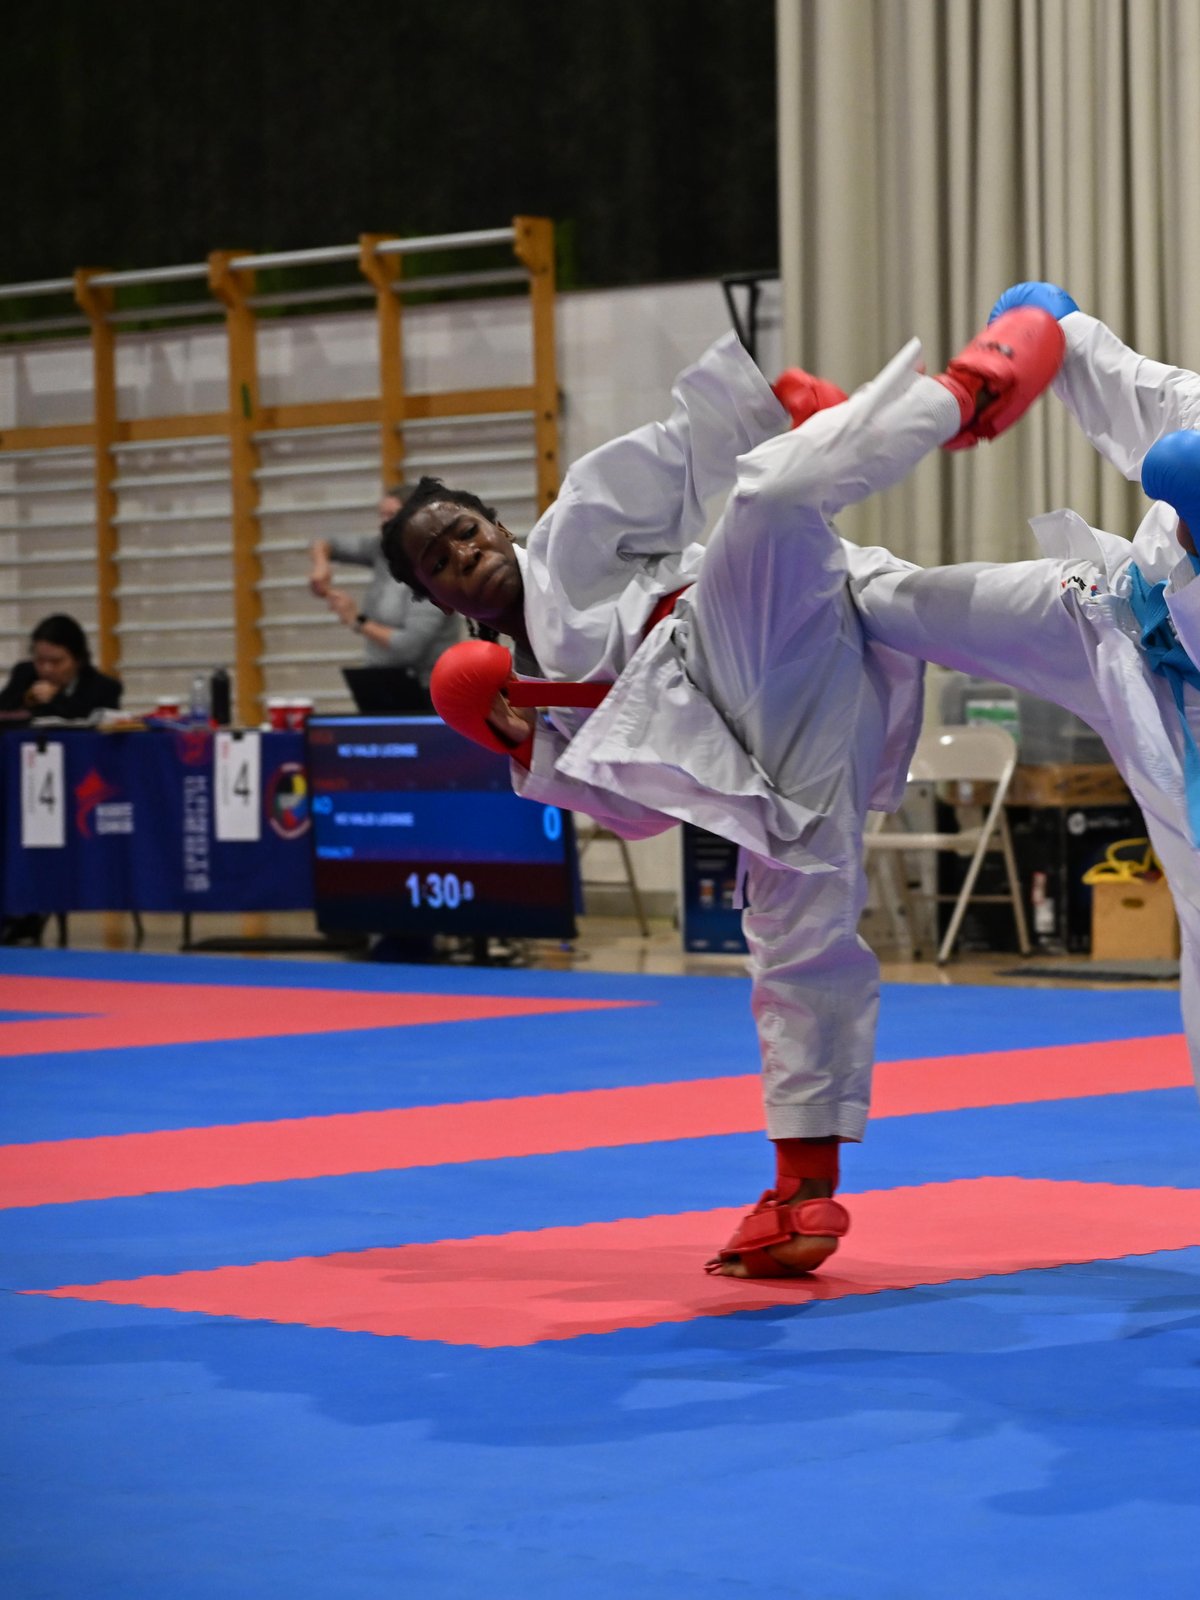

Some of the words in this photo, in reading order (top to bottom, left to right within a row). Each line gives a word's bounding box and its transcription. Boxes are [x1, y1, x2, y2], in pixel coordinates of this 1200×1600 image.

[39, 769, 56, 814] 4
[233, 761, 251, 807] 4
[542, 804, 562, 841] 0
